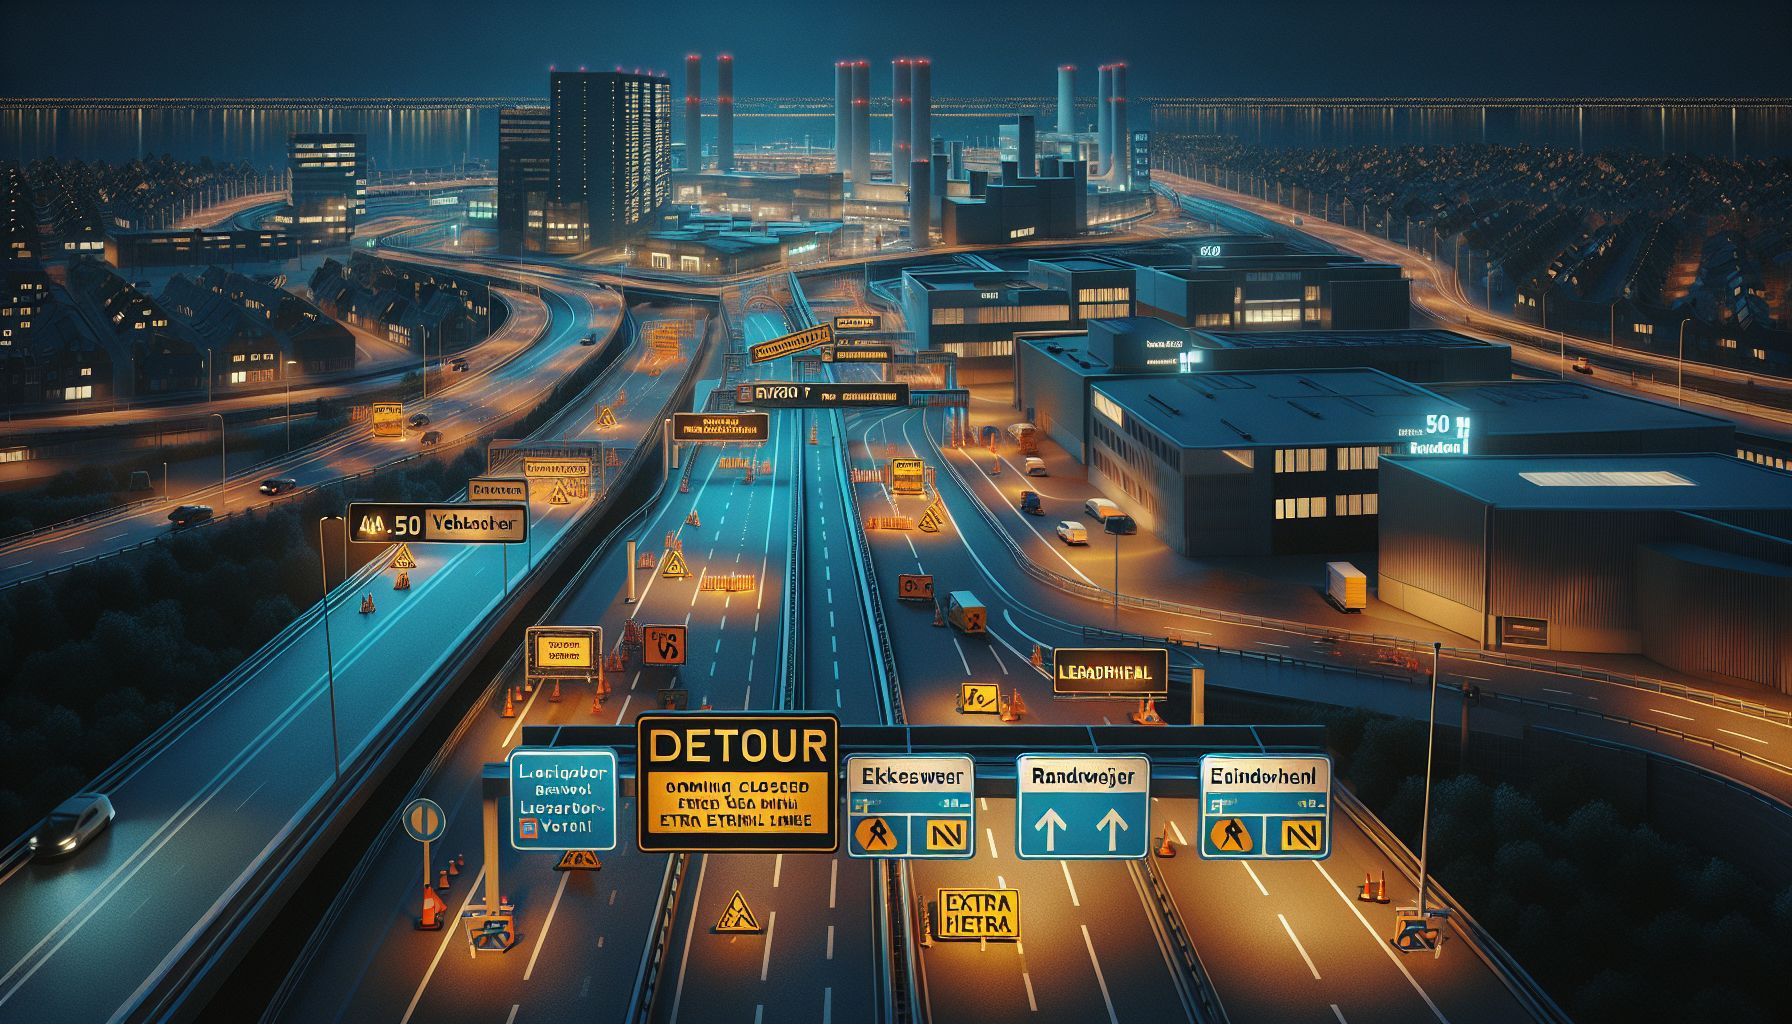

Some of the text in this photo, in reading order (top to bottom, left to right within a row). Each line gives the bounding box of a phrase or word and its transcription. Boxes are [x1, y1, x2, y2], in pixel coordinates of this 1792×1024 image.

[1426, 414, 1450, 433] 50
[650, 728, 827, 763] DETOUR
[946, 893, 1012, 912] EXTRA
